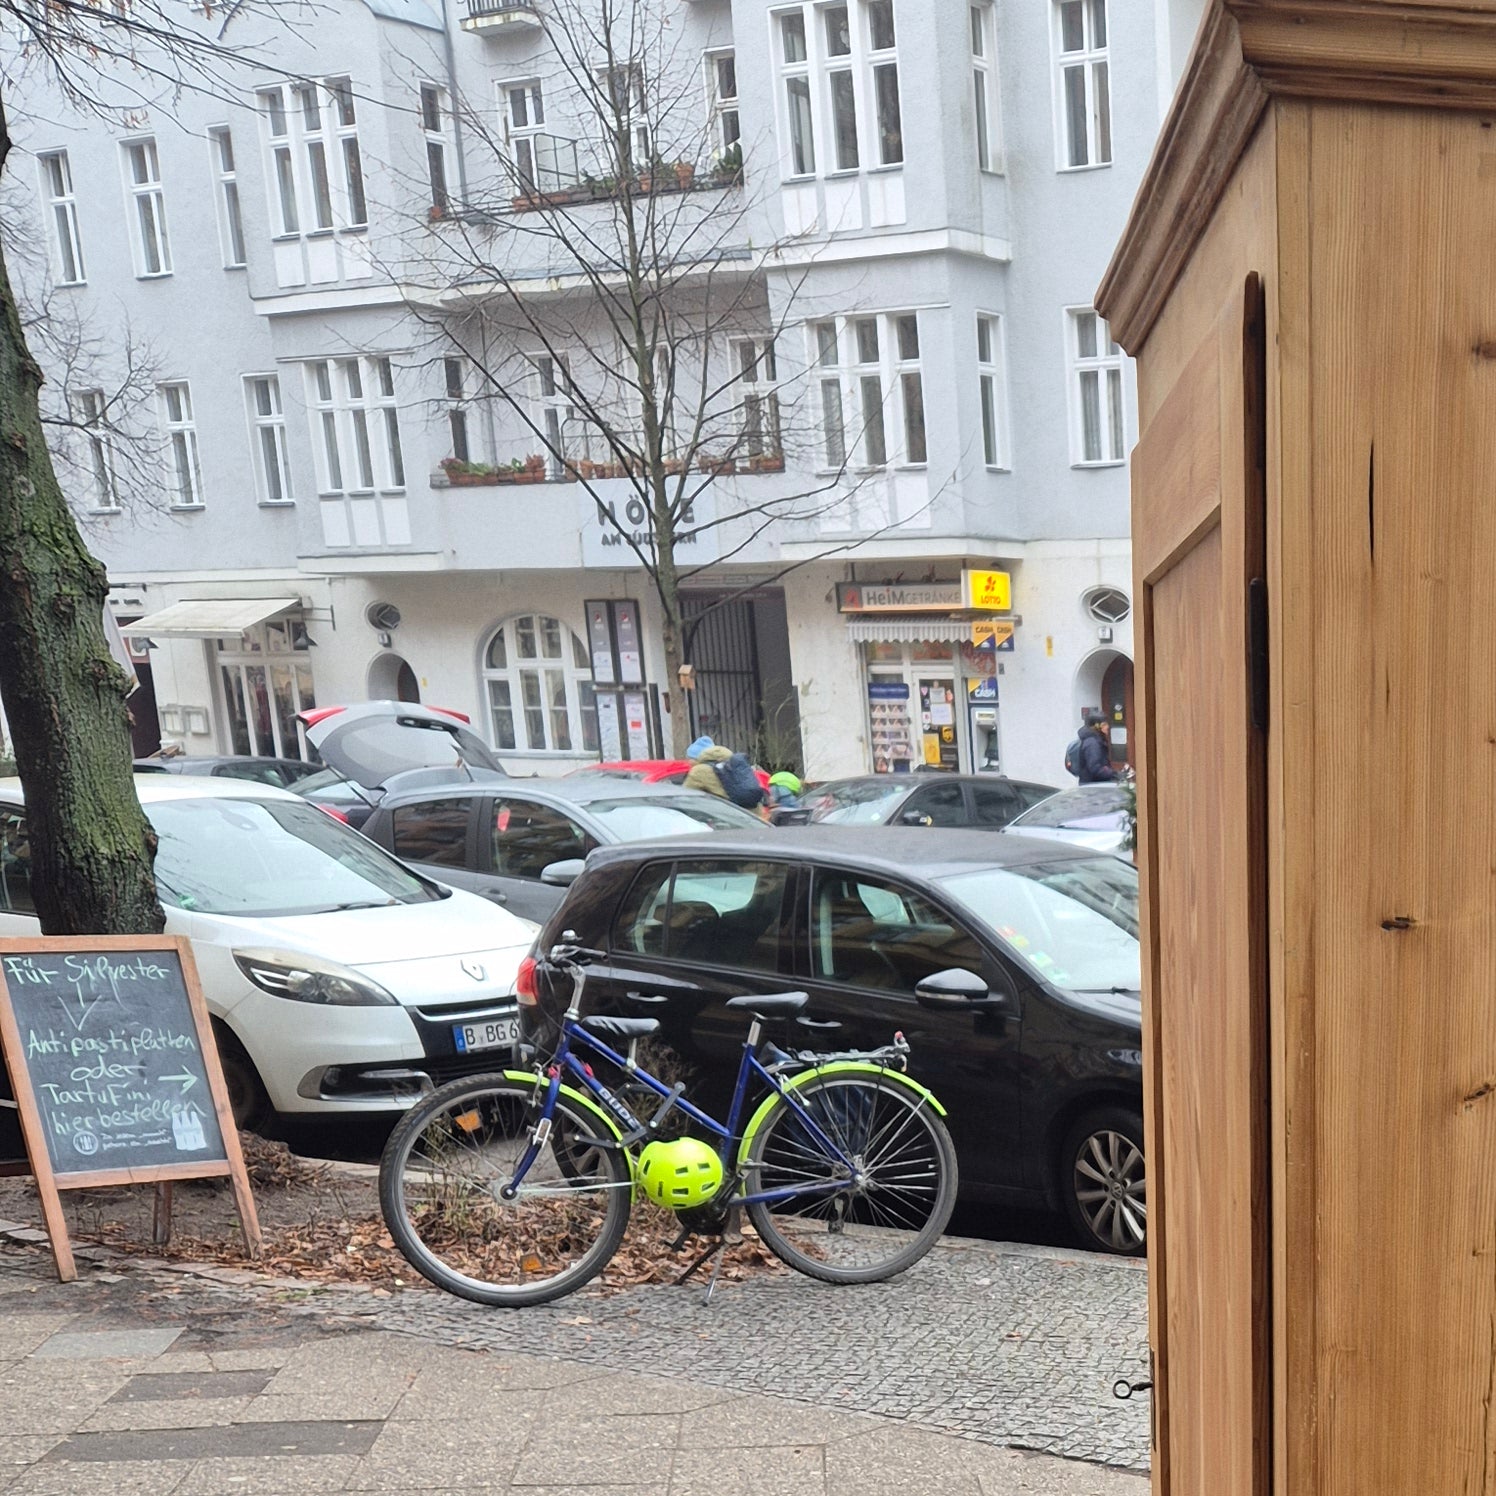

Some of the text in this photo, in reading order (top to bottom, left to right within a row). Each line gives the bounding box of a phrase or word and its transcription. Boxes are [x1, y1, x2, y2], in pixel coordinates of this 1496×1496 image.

[597, 494, 695, 526] HÖE
[981, 595, 1001, 605] LOTTO
[3, 954, 171, 985] Für Silvester
[28, 1028, 196, 1060] Antipastiplatten
[465, 1027, 476, 1046] B
[486, 1024, 507, 1043] BG
[70, 1055, 148, 1082] oder
